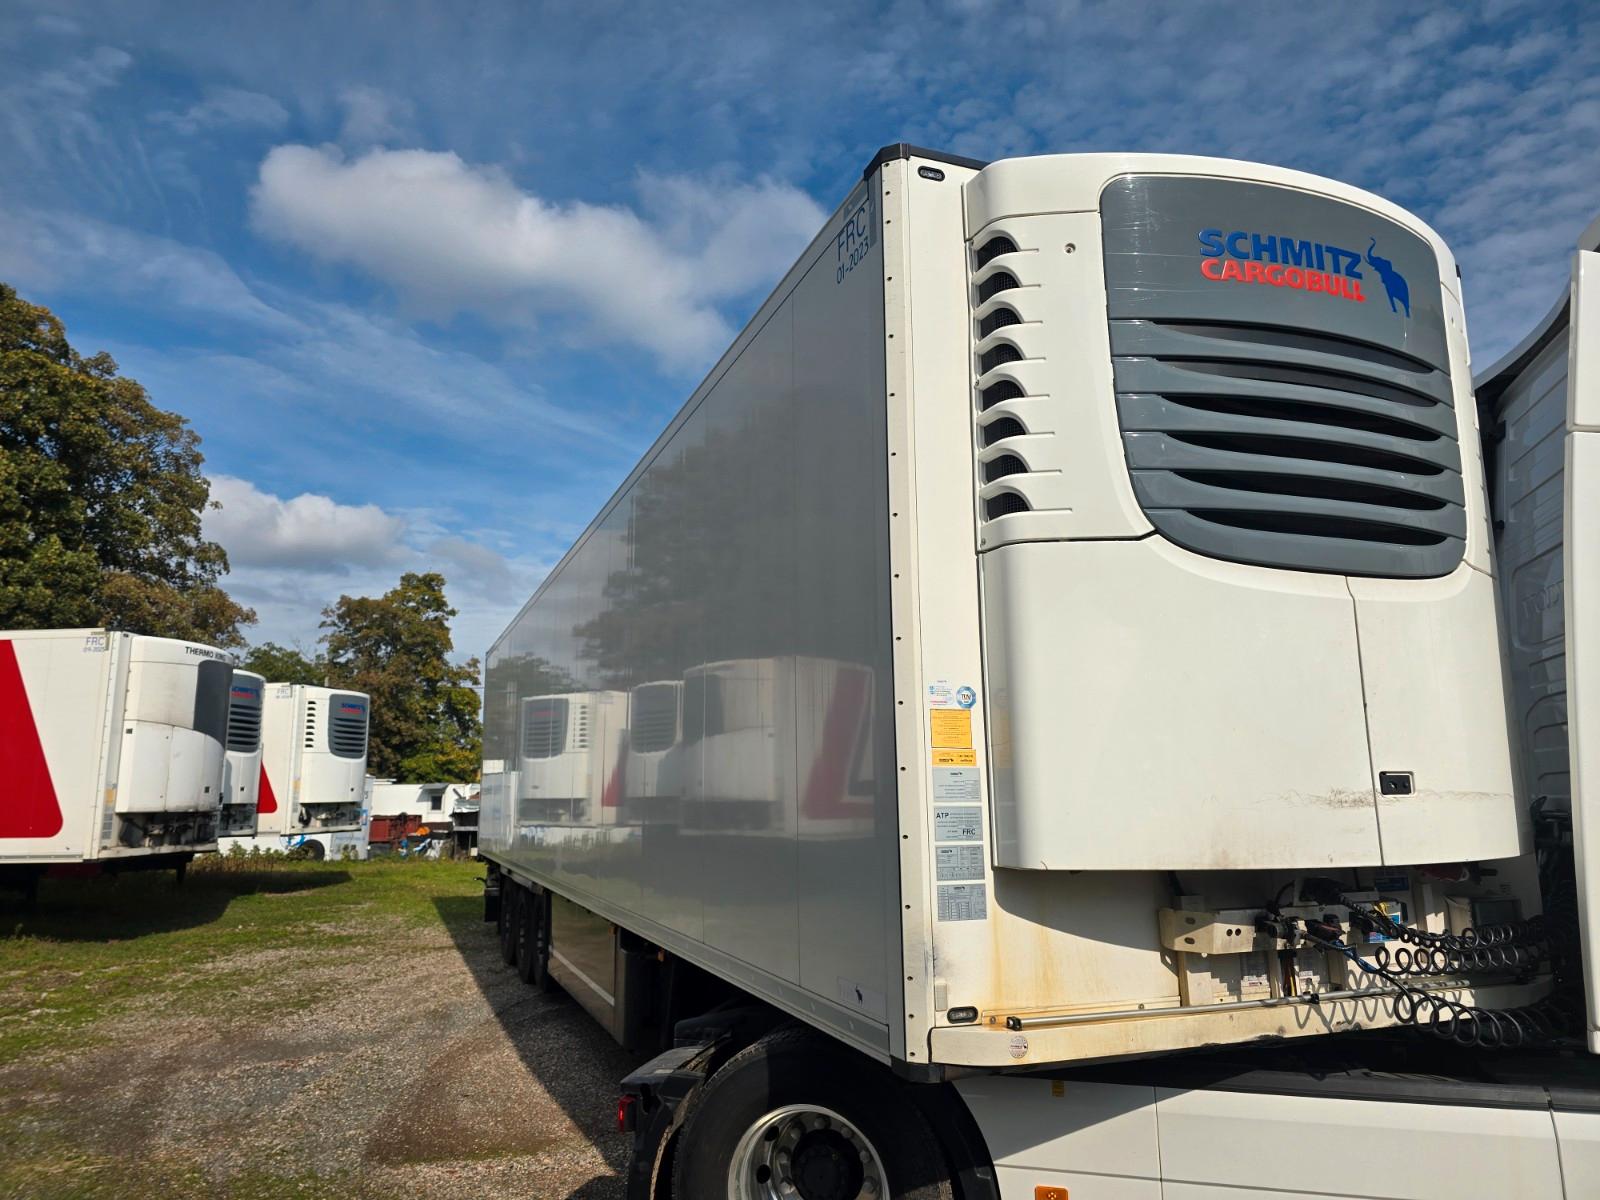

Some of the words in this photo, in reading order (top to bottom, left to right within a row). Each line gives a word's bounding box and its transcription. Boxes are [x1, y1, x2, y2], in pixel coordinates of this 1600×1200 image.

[837, 207, 866, 262] FRC
[1198, 228, 1363, 280] SCHMITZ
[836, 236, 869, 285] 01-2023
[1200, 259, 1366, 303] CARGOBULL
[86, 636, 105, 646] FRC
[185, 646, 214, 658] THERMO
[962, 828, 976, 836] FRC
